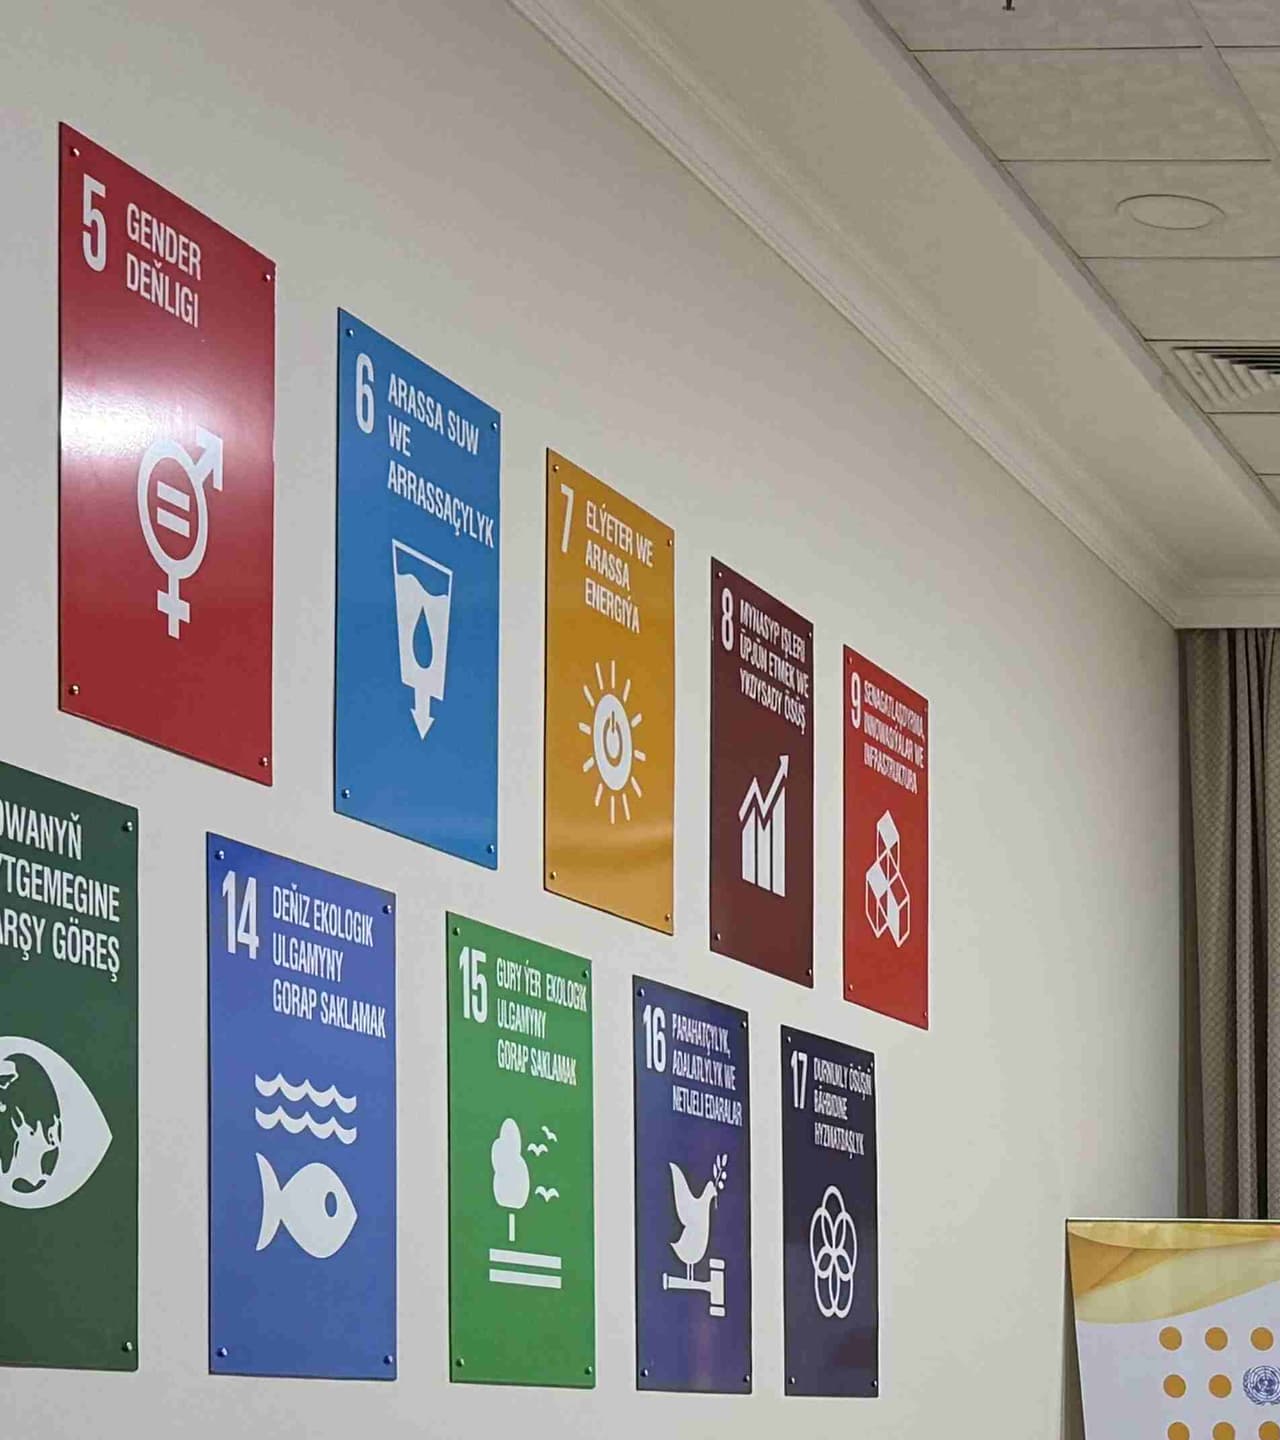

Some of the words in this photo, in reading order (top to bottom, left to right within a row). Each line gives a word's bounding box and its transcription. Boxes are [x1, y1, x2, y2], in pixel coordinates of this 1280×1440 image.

[83, 173, 107, 272] 5
[126, 202, 201, 280] GENDER
[126, 258, 198, 328] DEŇLIGI
[356, 353, 375, 434] 6
[388, 373, 444, 436] ARASSA
[447, 409, 479, 455] SUW
[388, 415, 411, 457] WE
[387, 460, 494, 548] ARRASSAÇYLYK
[561, 483, 574, 553] 7
[585, 540, 630, 591] ARASSA
[636, 532, 653, 568] WE
[585, 577, 640, 634] ENERGIÝA
[721, 588, 734, 651] 8
[796, 669, 809, 699] WE
[851, 671, 861, 729] 9
[222, 870, 259, 960] 14
[273, 882, 310, 928] DEŇIZ
[313, 899, 374, 948] EKOLOGIK
[52, 917, 121, 982] GÖREŞ
[273, 932, 344, 983] ULGAMYNY
[273, 978, 317, 1021] GORAP
[320, 991, 387, 1039] SAKLAMAK
[459, 946, 488, 1024] 15
[496, 957, 522, 993] GURY
[546, 973, 587, 1013] EKOLOGIK
[497, 998, 546, 1039] ULGAMYNY
[643, 1004, 666, 1073] 16
[497, 1038, 529, 1074] GORAP
[530, 1048, 577, 1086] SAKLAMAK
[724, 1063, 736, 1091] WE
[791, 1050, 808, 1109] 17
